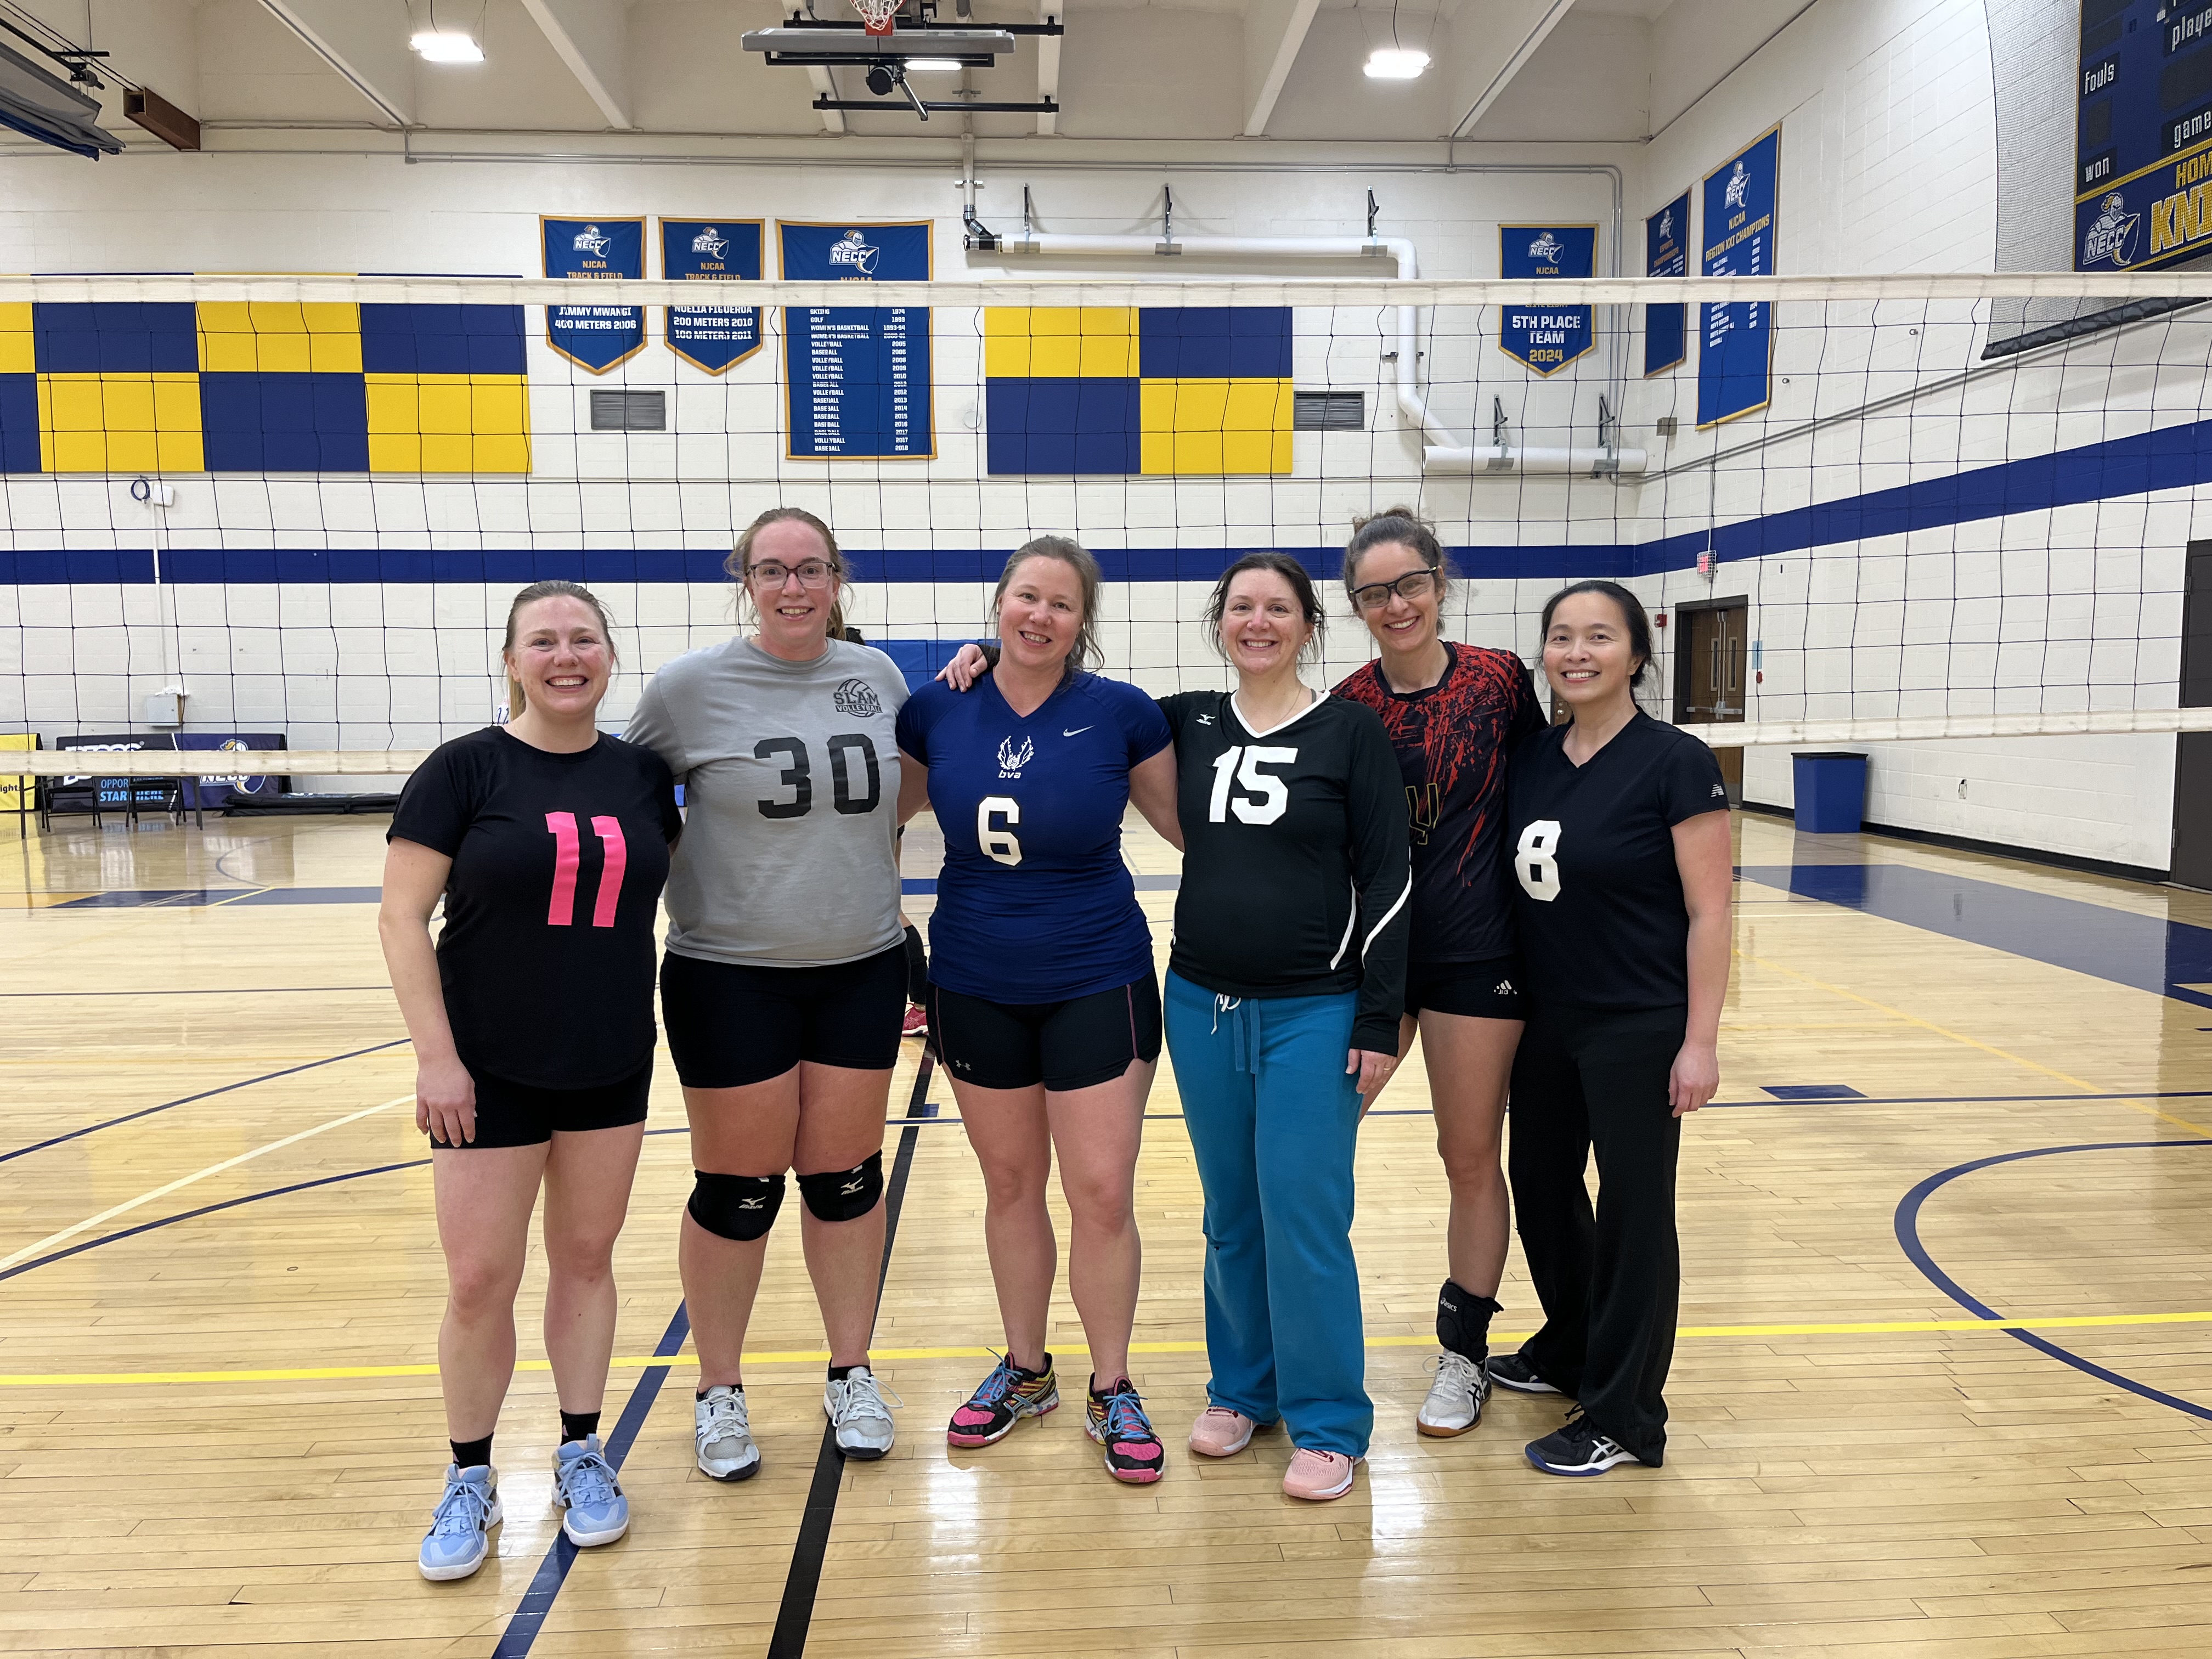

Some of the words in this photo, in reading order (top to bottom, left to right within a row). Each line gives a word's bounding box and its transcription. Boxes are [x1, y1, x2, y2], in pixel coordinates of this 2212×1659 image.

[2085, 61, 2114, 94] fouls
[2174, 111, 2211, 148] game
[2085, 157, 2109, 182] won
[1726, 182, 1744, 206] NECC
[1729, 210, 1745, 230] NJCAA
[1706, 240, 1725, 262] REGION
[1736, 213, 1770, 244] CHAMPIONS
[2086, 227, 2124, 259] NECC
[575, 240, 601, 249] NECC
[694, 241, 720, 251] NECC
[831, 250, 866, 263] NECC
[1530, 247, 1555, 256] NECC
[583, 261, 607, 269] NJCAA
[701, 262, 725, 270] NJCAA
[559, 306, 591, 316] JIMMY
[593, 307, 631, 317] MWANGI
[555, 320, 573, 329] 400
[575, 320, 612, 330] METERS
[613, 320, 636, 330] 2006
[674, 316, 691, 326] 200
[693, 318, 729, 327] METERS
[731, 318, 753, 327] 2010
[1513, 315, 1537, 328] 5TH
[1541, 315, 1580, 329] PLACE
[675, 329, 692, 340] 100
[694, 330, 730, 340] METERS
[732, 330, 752, 340] 2011
[1530, 331, 1564, 343] TEAM
[1529, 349, 1563, 362] 2024
[833, 691, 881, 706] SLAM
[836, 704, 882, 713] VOLLEYBALL
[754, 734, 881, 819] 30
[998, 770, 1022, 779] bva
[1209, 744, 1299, 825] 15
[100, 791, 132, 802] STAR
[978, 796, 1023, 866] 6
[1515, 820, 1562, 902] 8
[545, 811, 627, 928] 11
